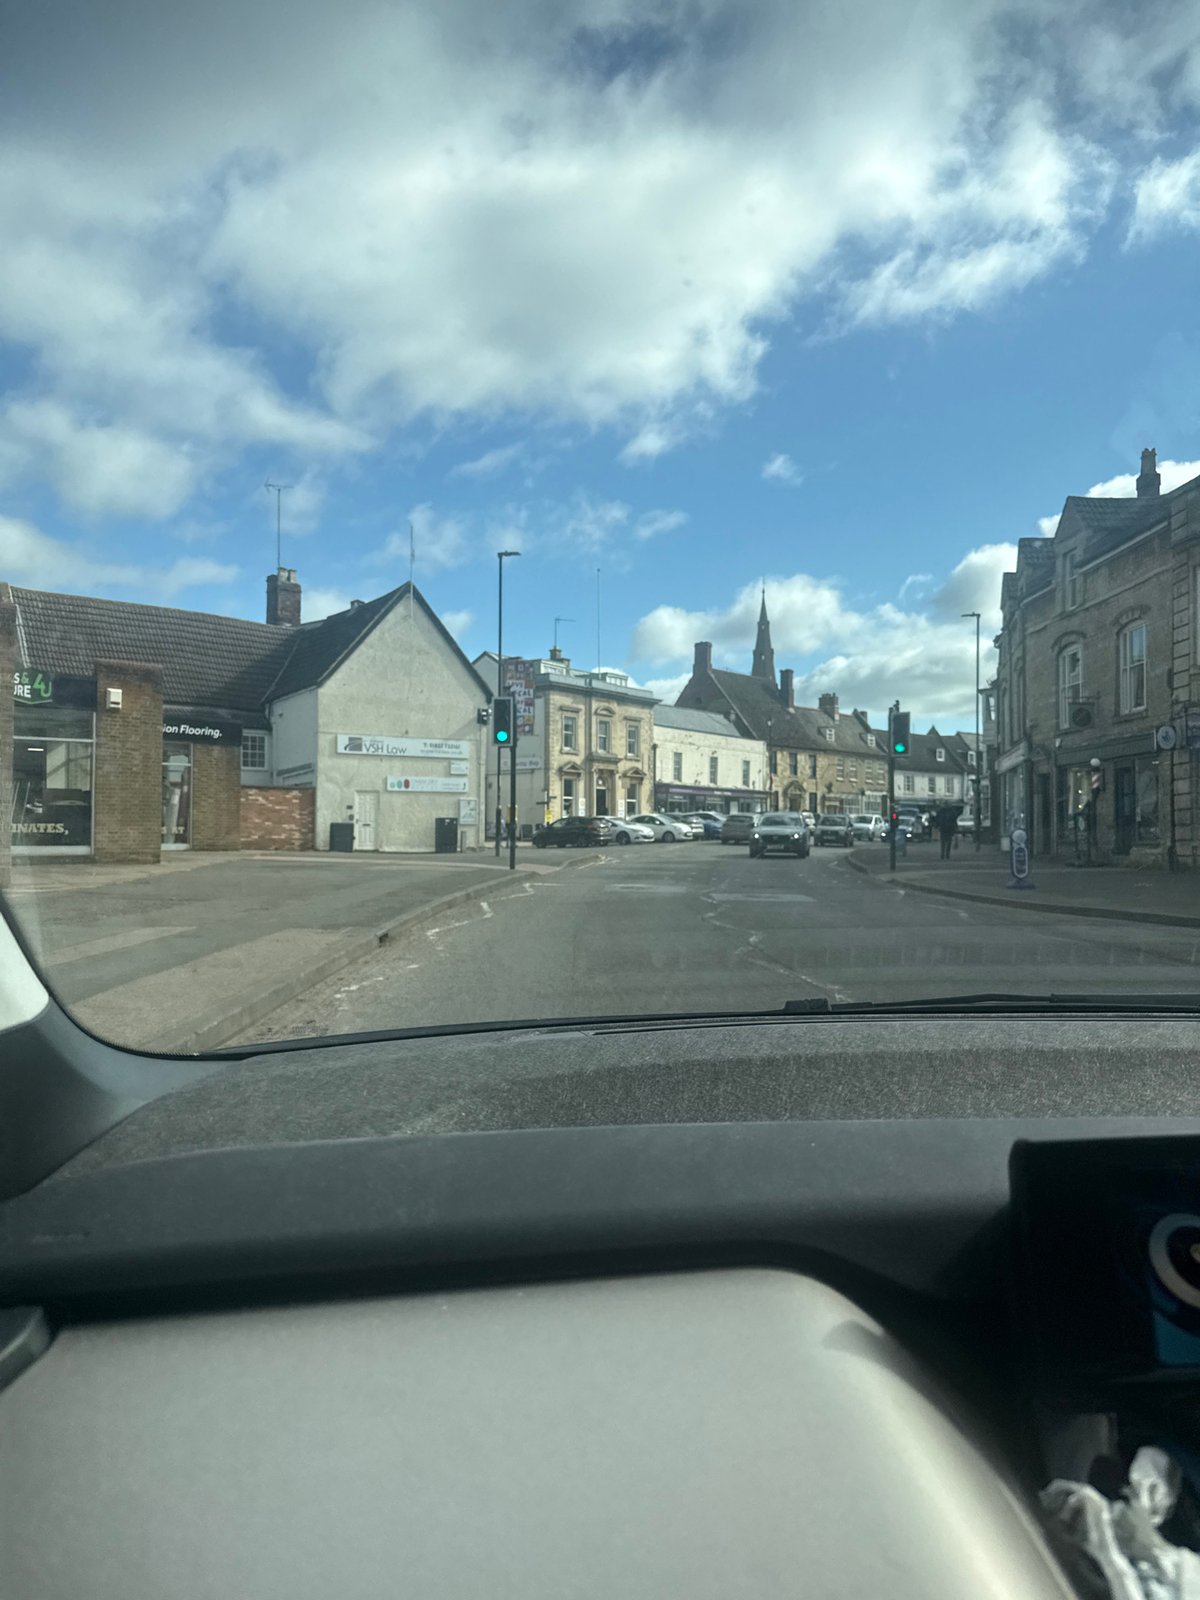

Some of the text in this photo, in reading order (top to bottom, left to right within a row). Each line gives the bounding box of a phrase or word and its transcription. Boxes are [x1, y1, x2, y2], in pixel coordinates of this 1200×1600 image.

[180, 724, 223, 739] Flooring.
[364, 743, 408, 754] VSH Law
